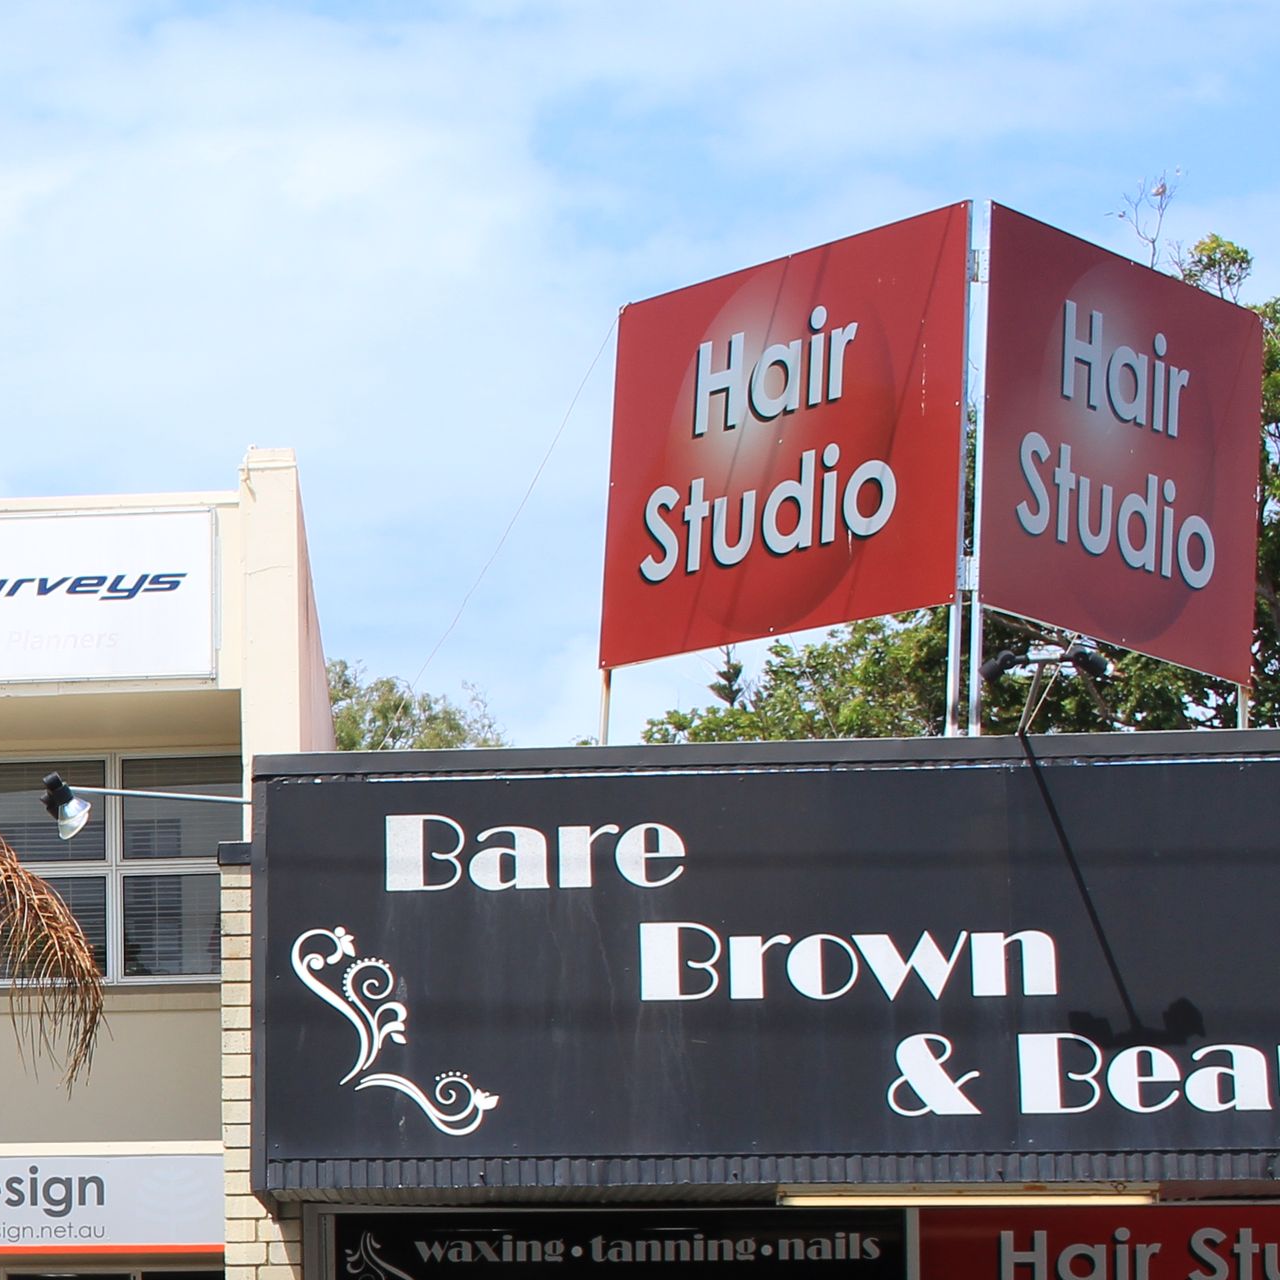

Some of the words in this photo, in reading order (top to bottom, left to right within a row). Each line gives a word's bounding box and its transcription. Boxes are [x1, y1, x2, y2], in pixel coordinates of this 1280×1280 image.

[692, 305, 858, 437] Hair
[1062, 299, 1189, 437] Hair
[640, 443, 897, 584] Studio
[1016, 432, 1215, 589] Studio
[384, 814, 686, 892] Bare
[639, 921, 1058, 1001] Brown
[886, 1032, 981, 1117] &
[1017, 1031, 1280, 1115] Bea
[414, 1234, 564, 1263] waxing
[591, 1233, 756, 1262] tanning
[777, 1232, 881, 1261] nails
